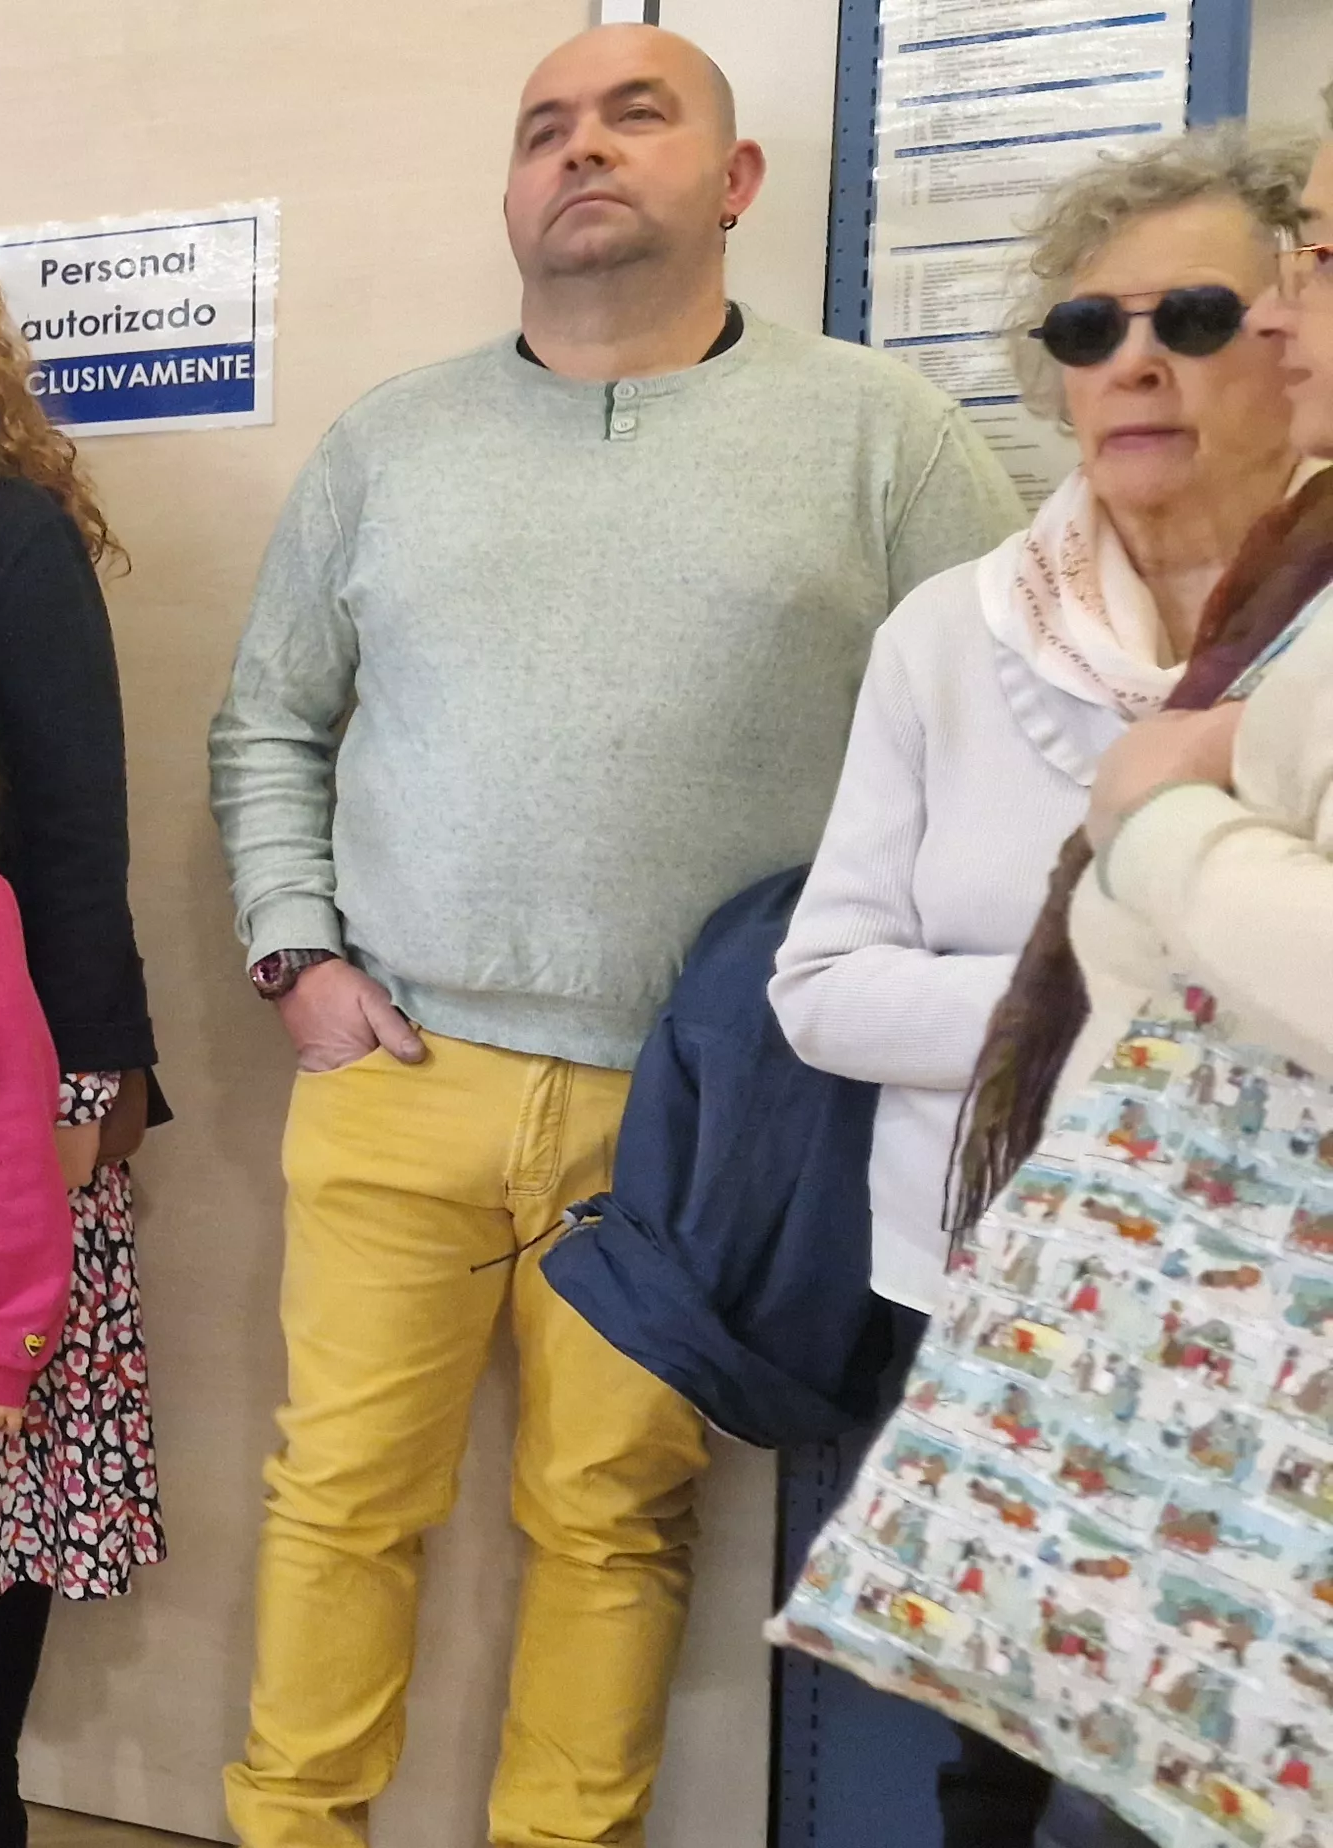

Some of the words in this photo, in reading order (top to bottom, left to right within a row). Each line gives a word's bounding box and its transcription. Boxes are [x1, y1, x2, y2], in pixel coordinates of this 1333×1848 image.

[40, 242, 197, 288] Personal
[21, 297, 217, 342] autorizado
[25, 353, 254, 397] CLUSIVAMENTE.
